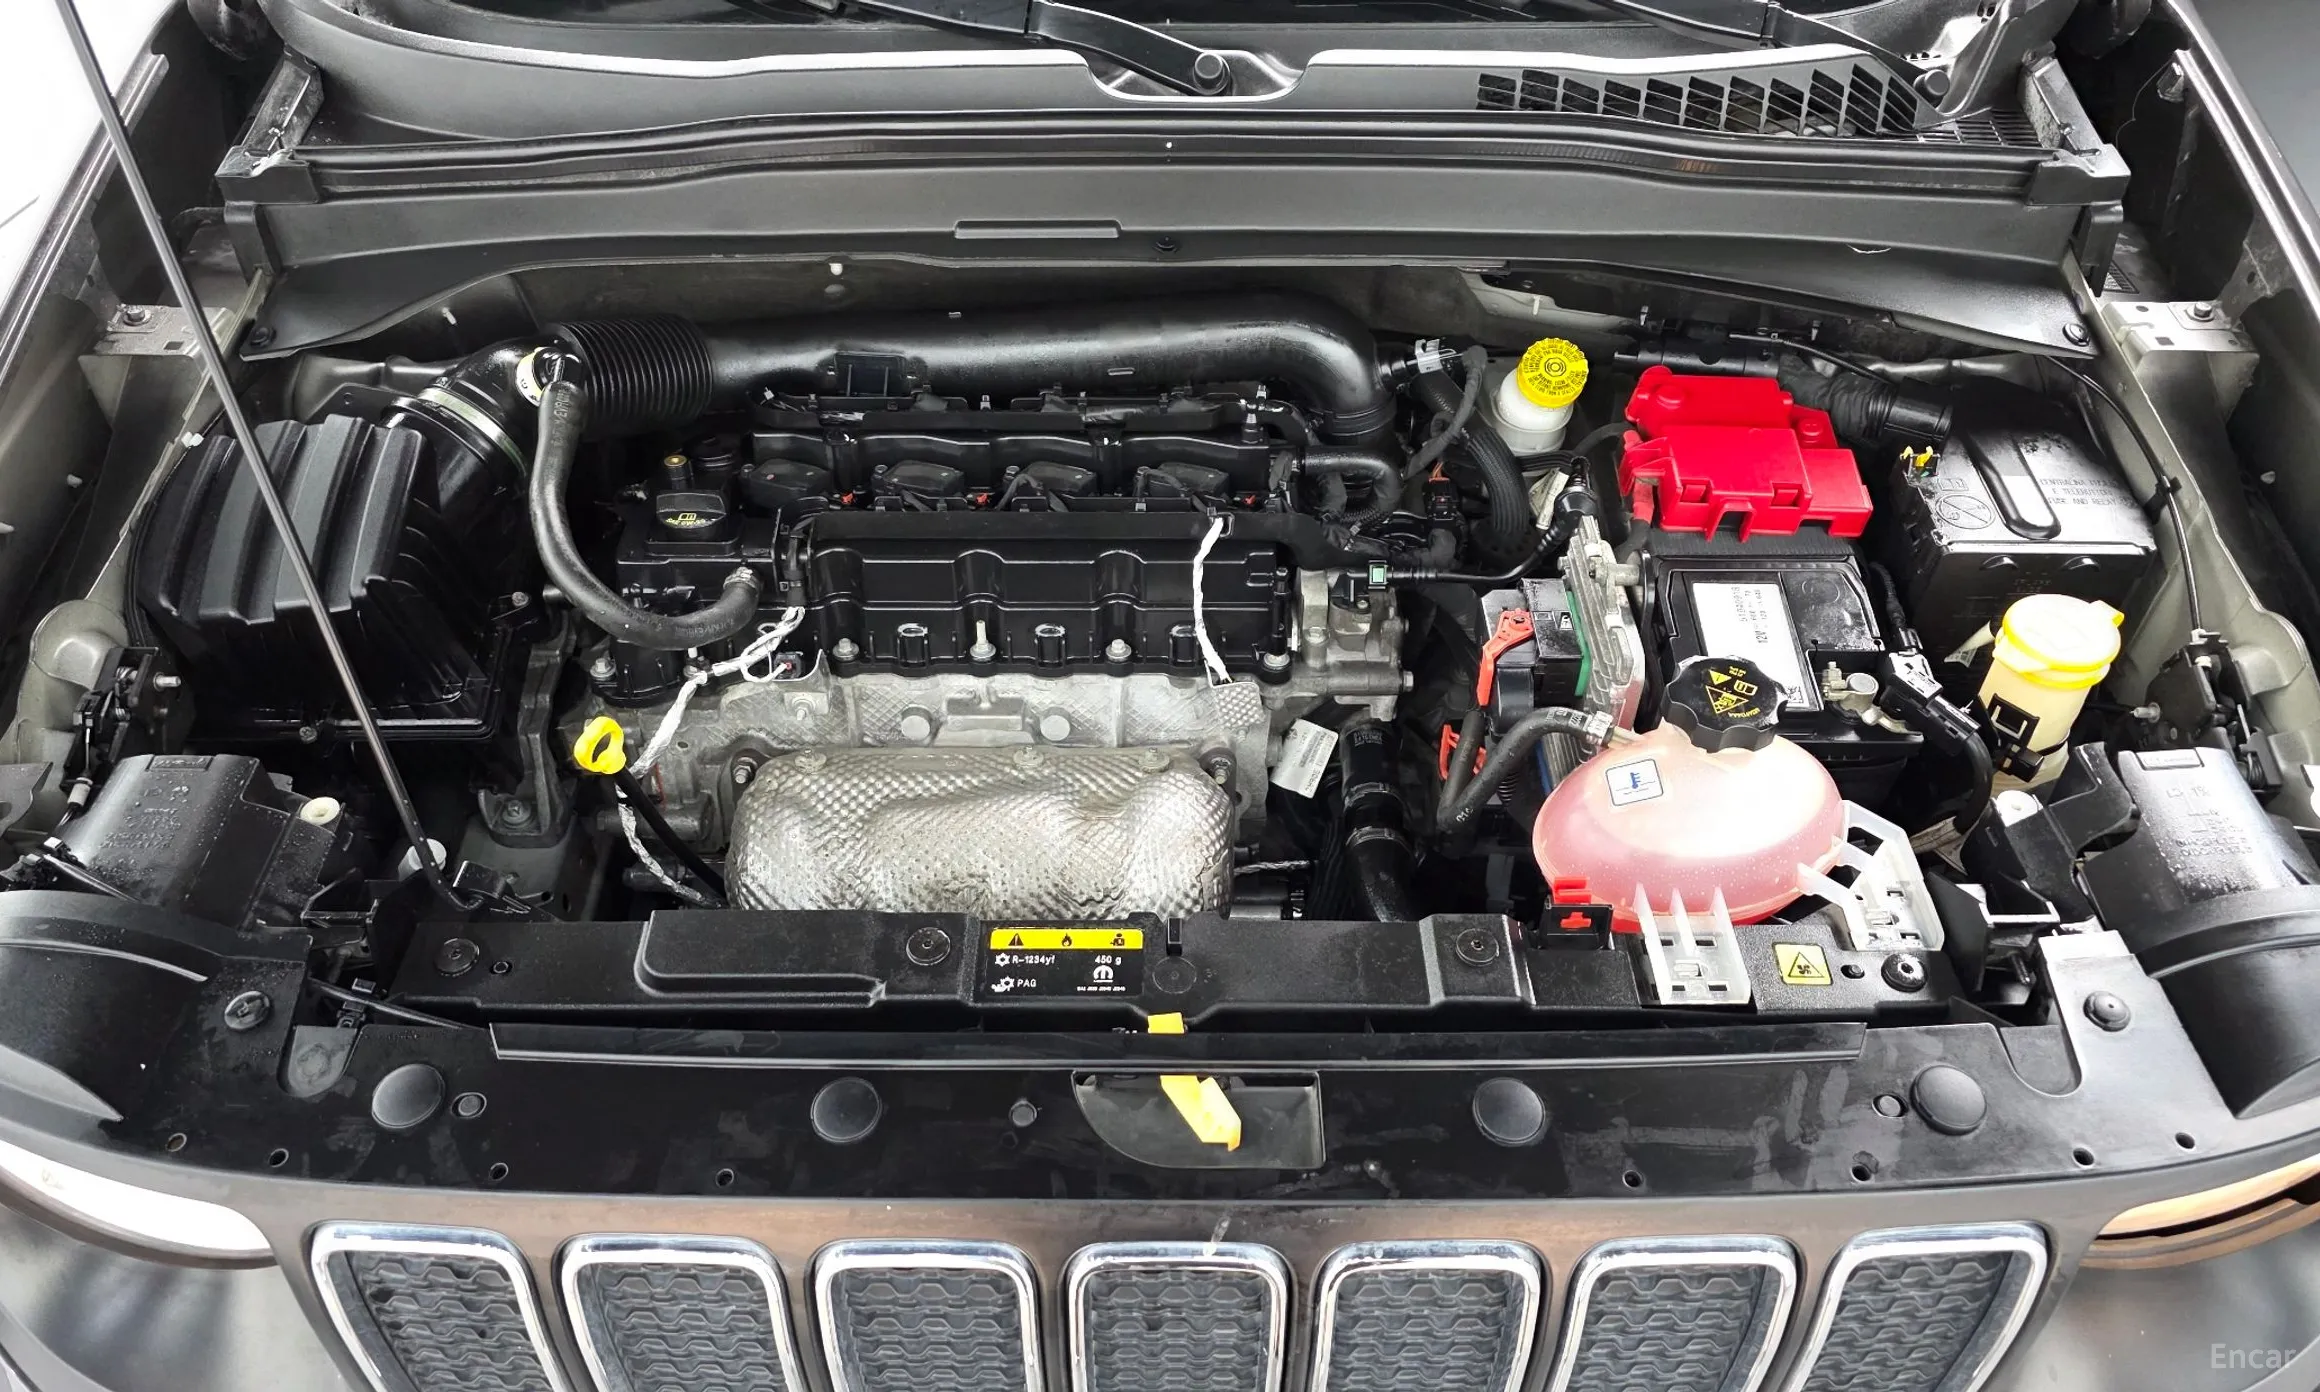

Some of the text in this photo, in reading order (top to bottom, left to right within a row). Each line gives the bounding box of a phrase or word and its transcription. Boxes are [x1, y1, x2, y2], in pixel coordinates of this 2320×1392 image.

[1012, 954, 1056, 966] R-1234yf
[1094, 954, 1122, 966] 450 g
[1017, 978, 1037, 988] PAG
